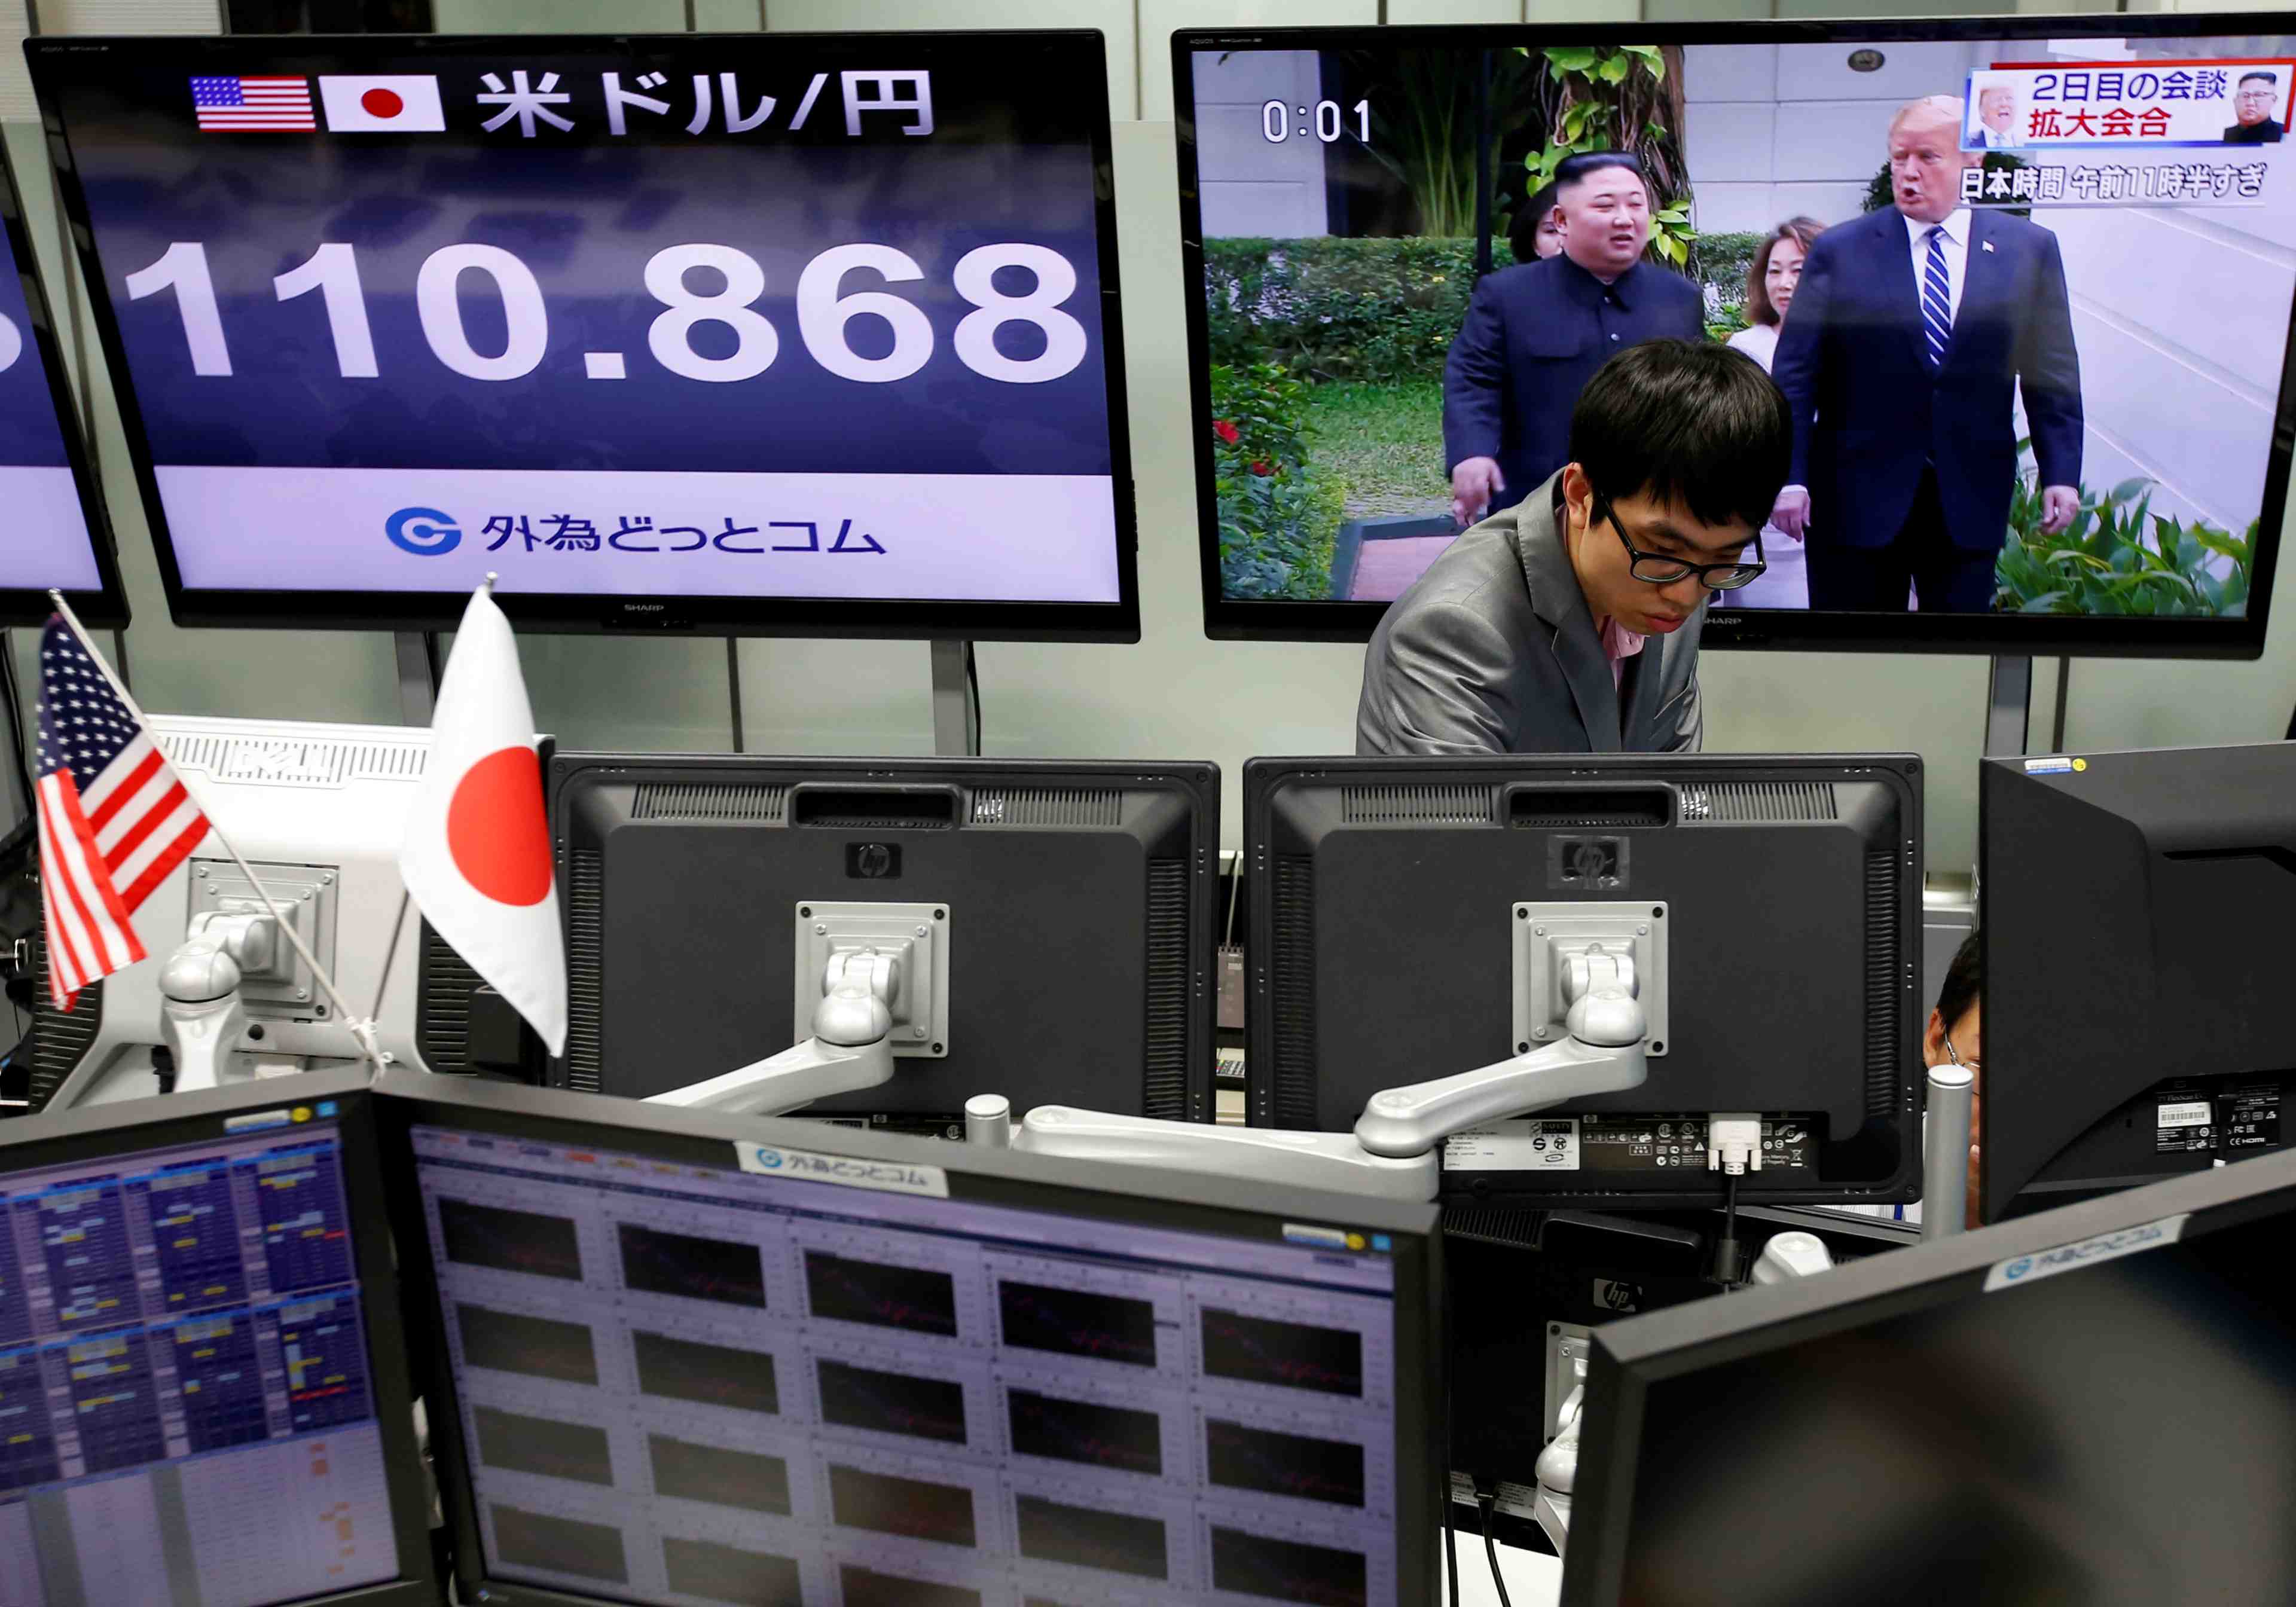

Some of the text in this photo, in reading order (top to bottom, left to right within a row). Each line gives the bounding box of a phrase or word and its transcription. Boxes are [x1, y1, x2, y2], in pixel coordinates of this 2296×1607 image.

[477, 70, 935, 138] 米ドル/円
[2032, 70, 2228, 102] 2日目の会談
[1262, 99, 1369, 143] 0:01
[2028, 107, 2172, 139] 拡大会合
[1960, 165, 2065, 200] 日本時間
[125, 242, 1088, 384] 110.868
[481, 514, 887, 555] 外為どっとコム
[624, 603, 664, 612] SHARP
